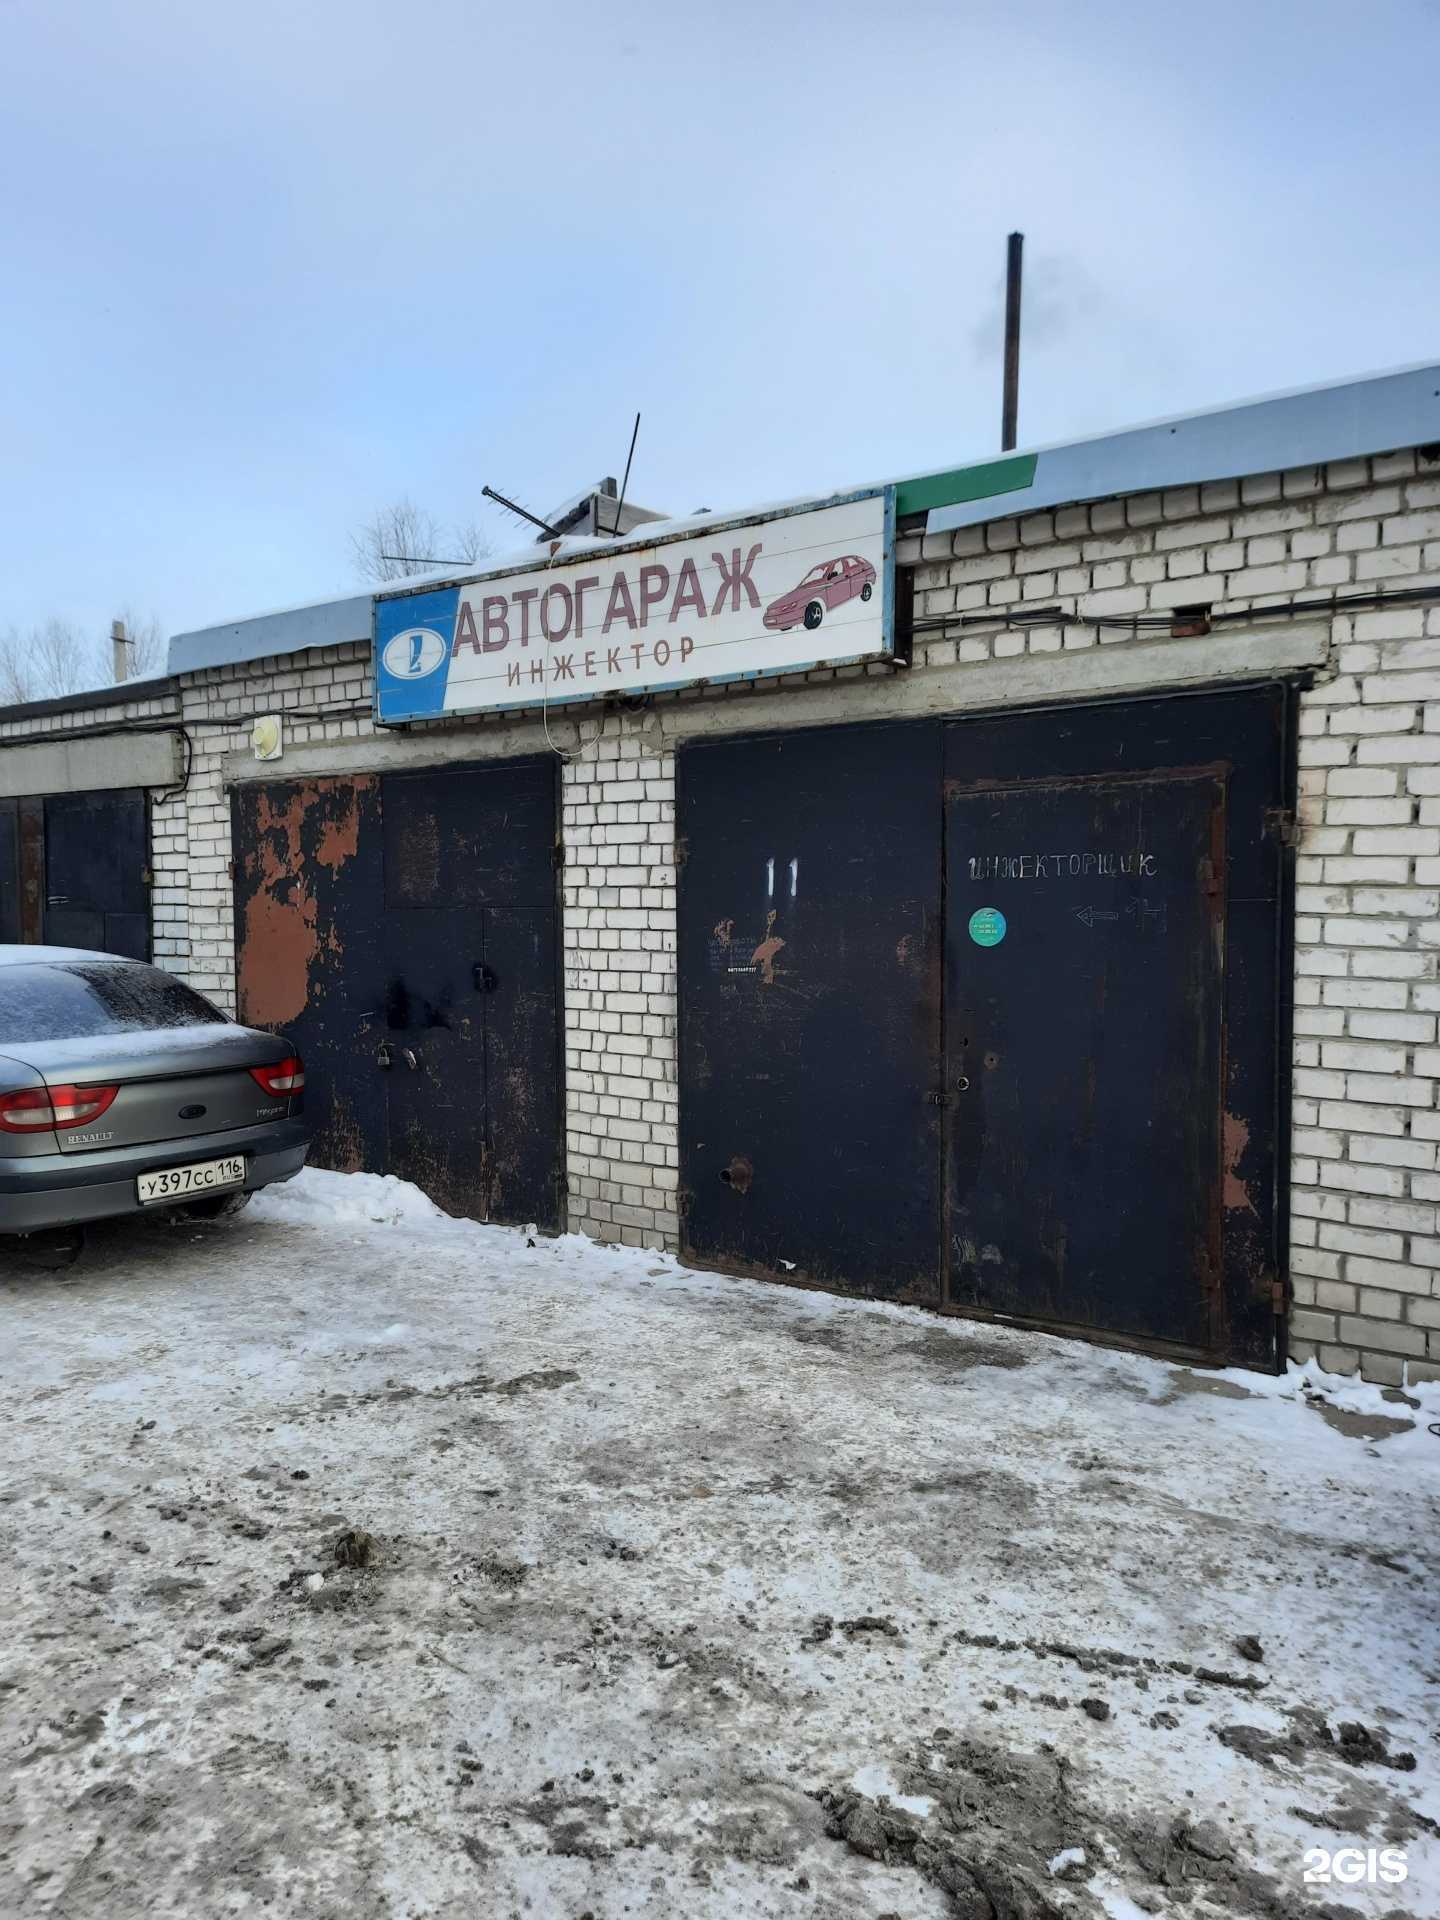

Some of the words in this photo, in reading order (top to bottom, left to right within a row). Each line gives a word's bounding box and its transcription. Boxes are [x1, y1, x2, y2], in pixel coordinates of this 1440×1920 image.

[451, 543, 763, 658] АВТОГАРАЖ
[507, 636, 695, 687] ИНЖЕКТОР
[766, 857, 798, 896] 11
[217, 1159, 240, 1176] 116
